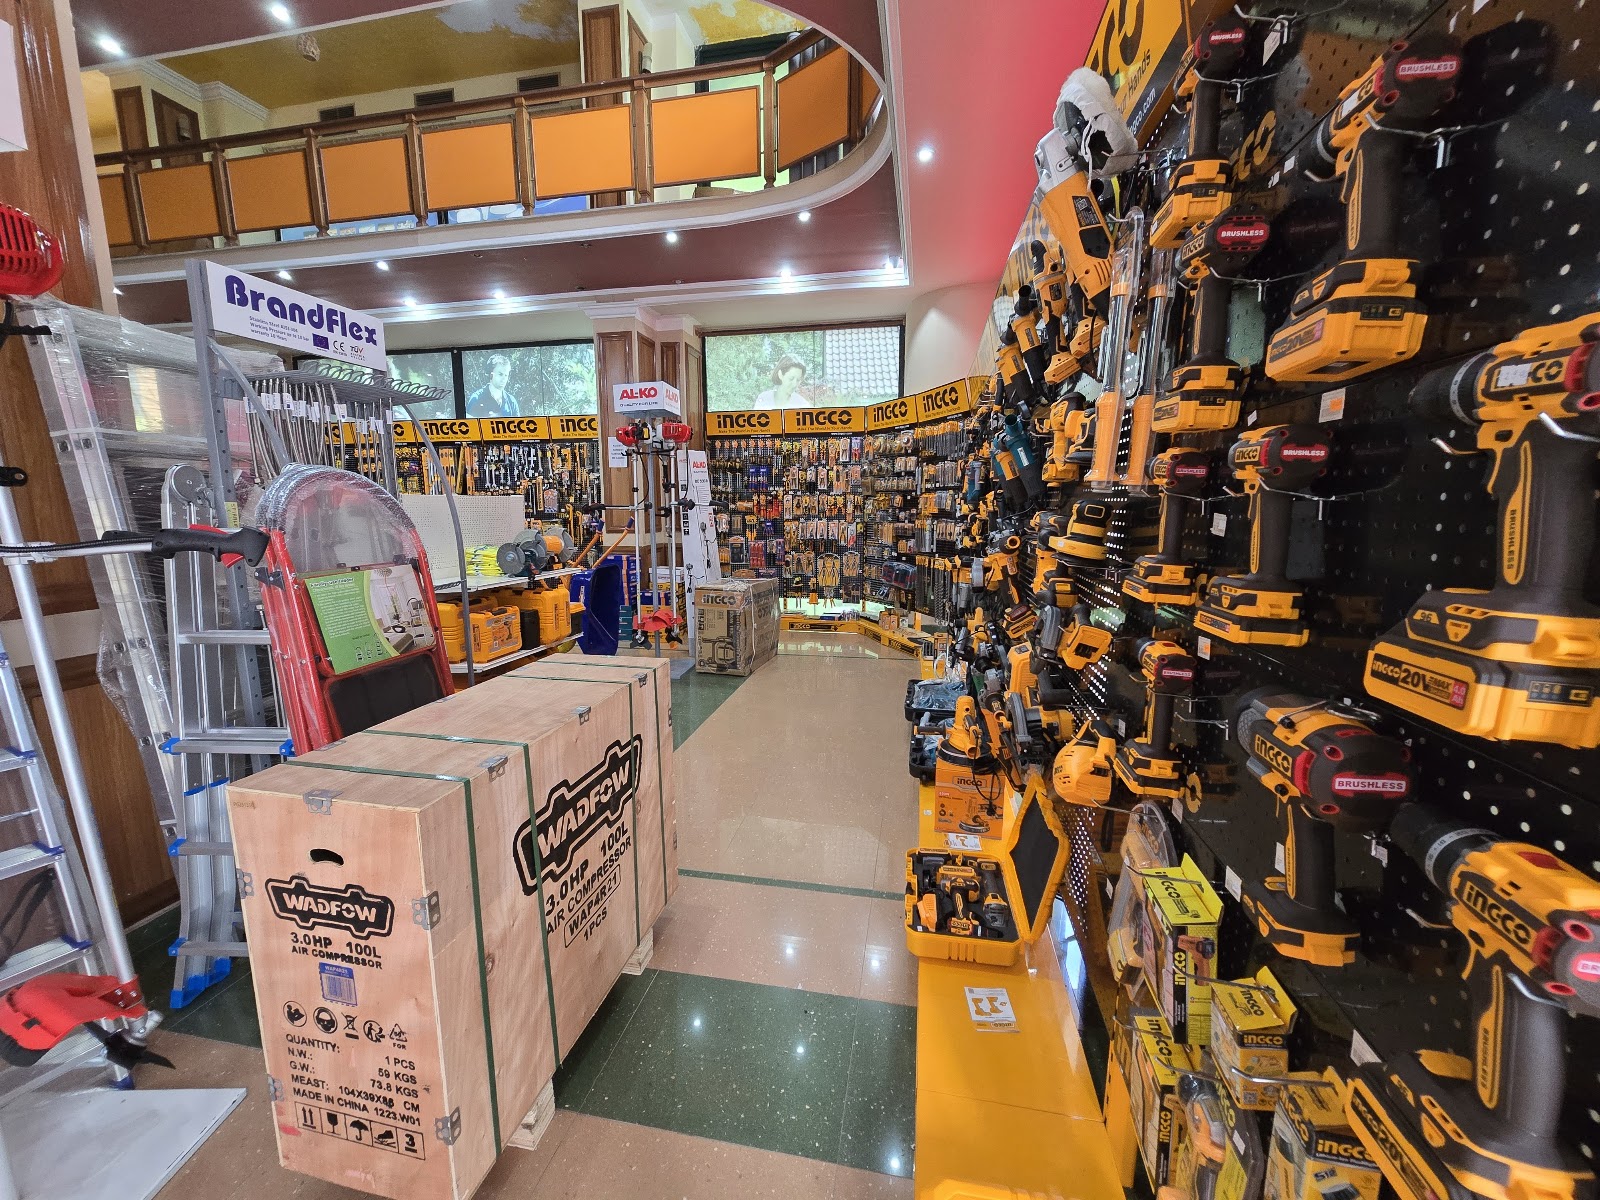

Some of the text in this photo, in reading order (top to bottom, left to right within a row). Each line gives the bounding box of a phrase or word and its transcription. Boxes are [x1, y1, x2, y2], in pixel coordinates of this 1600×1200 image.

[1128, 48, 1151, 99] Hands
[1400, 61, 1457, 74] BRUSHLESS
[1220, 229, 1265, 238] BRUSHLESS
[619, 386, 658, 401] AL-KO
[559, 418, 598, 433] INGC
[1283, 448, 1326, 457] BRUSHLESS
[1506, 509, 1517, 570] BRUSHLESS
[1453, 685, 1467, 696] 4.0
[1337, 779, 1404, 790] BRUSHLESS
[538, 760, 630, 859] WADFOW
[600, 820, 629, 858] 100L
[546, 835, 632, 936] AIR COMPRESSOR
[282, 892, 377, 923] WADFOW
[291, 945, 383, 970] AIR COMPRESSOR
[345, 941, 382, 959] 100L
[286, 1033, 416, 1071] QUANTITY: 1 PCS
[287, 1047, 313, 1061] N.W.:
[394, 1071, 418, 1085] KGS
[289, 1060, 419, 1099] G.W.: 73.8 KGS
[291, 1074, 329, 1090] MEAST:
[403, 1101, 420, 1113] CM
[293, 1087, 322, 1102] MADE
[324, 1094, 335, 1105] IN
[337, 1097, 370, 1113] CHINA
